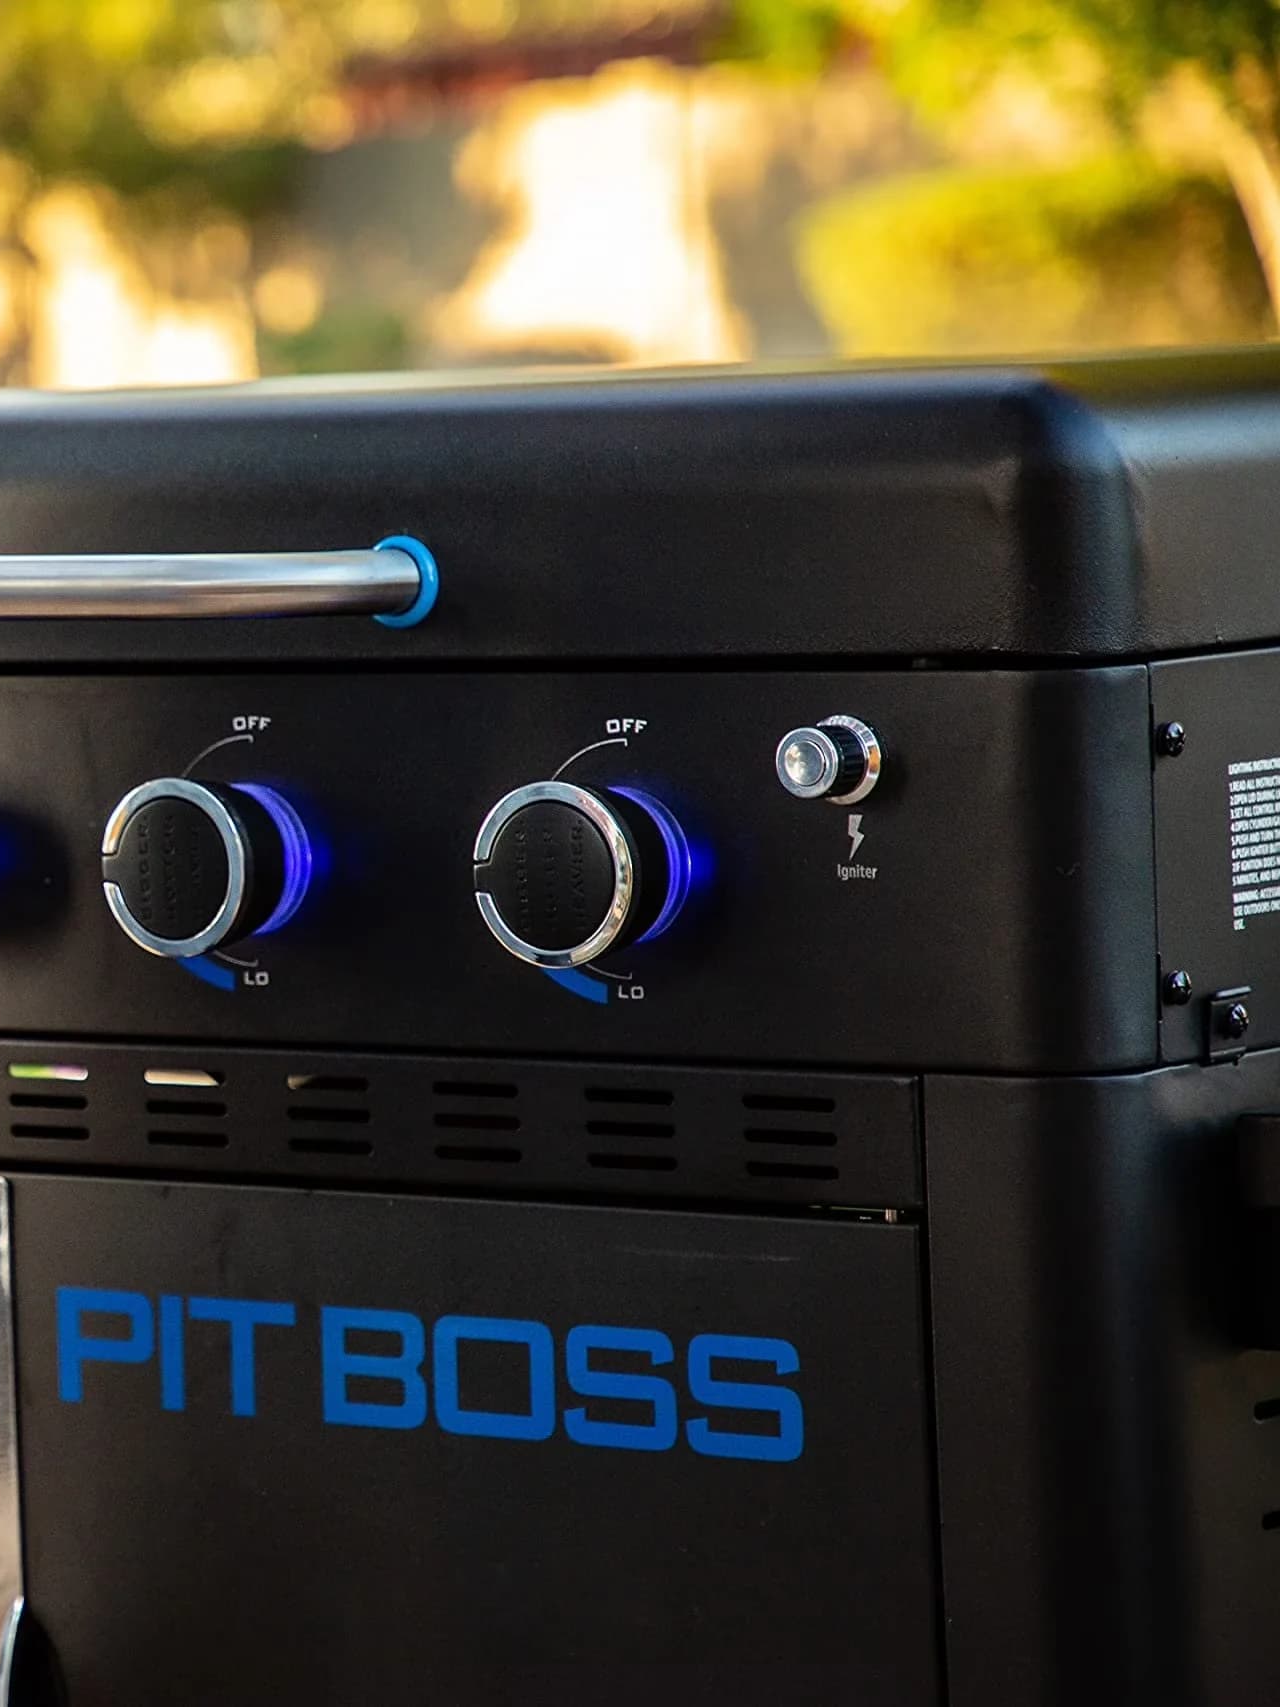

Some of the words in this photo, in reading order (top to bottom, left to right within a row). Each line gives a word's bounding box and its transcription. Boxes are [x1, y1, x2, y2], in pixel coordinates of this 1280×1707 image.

[232, 716, 271, 731] OFF
[606, 718, 648, 733] OFF
[837, 864, 878, 881] Igniter
[244, 971, 269, 986] LO
[618, 984, 644, 999] LO
[55, 1285, 296, 1417] PIT
[320, 1305, 804, 1462] BOSS
